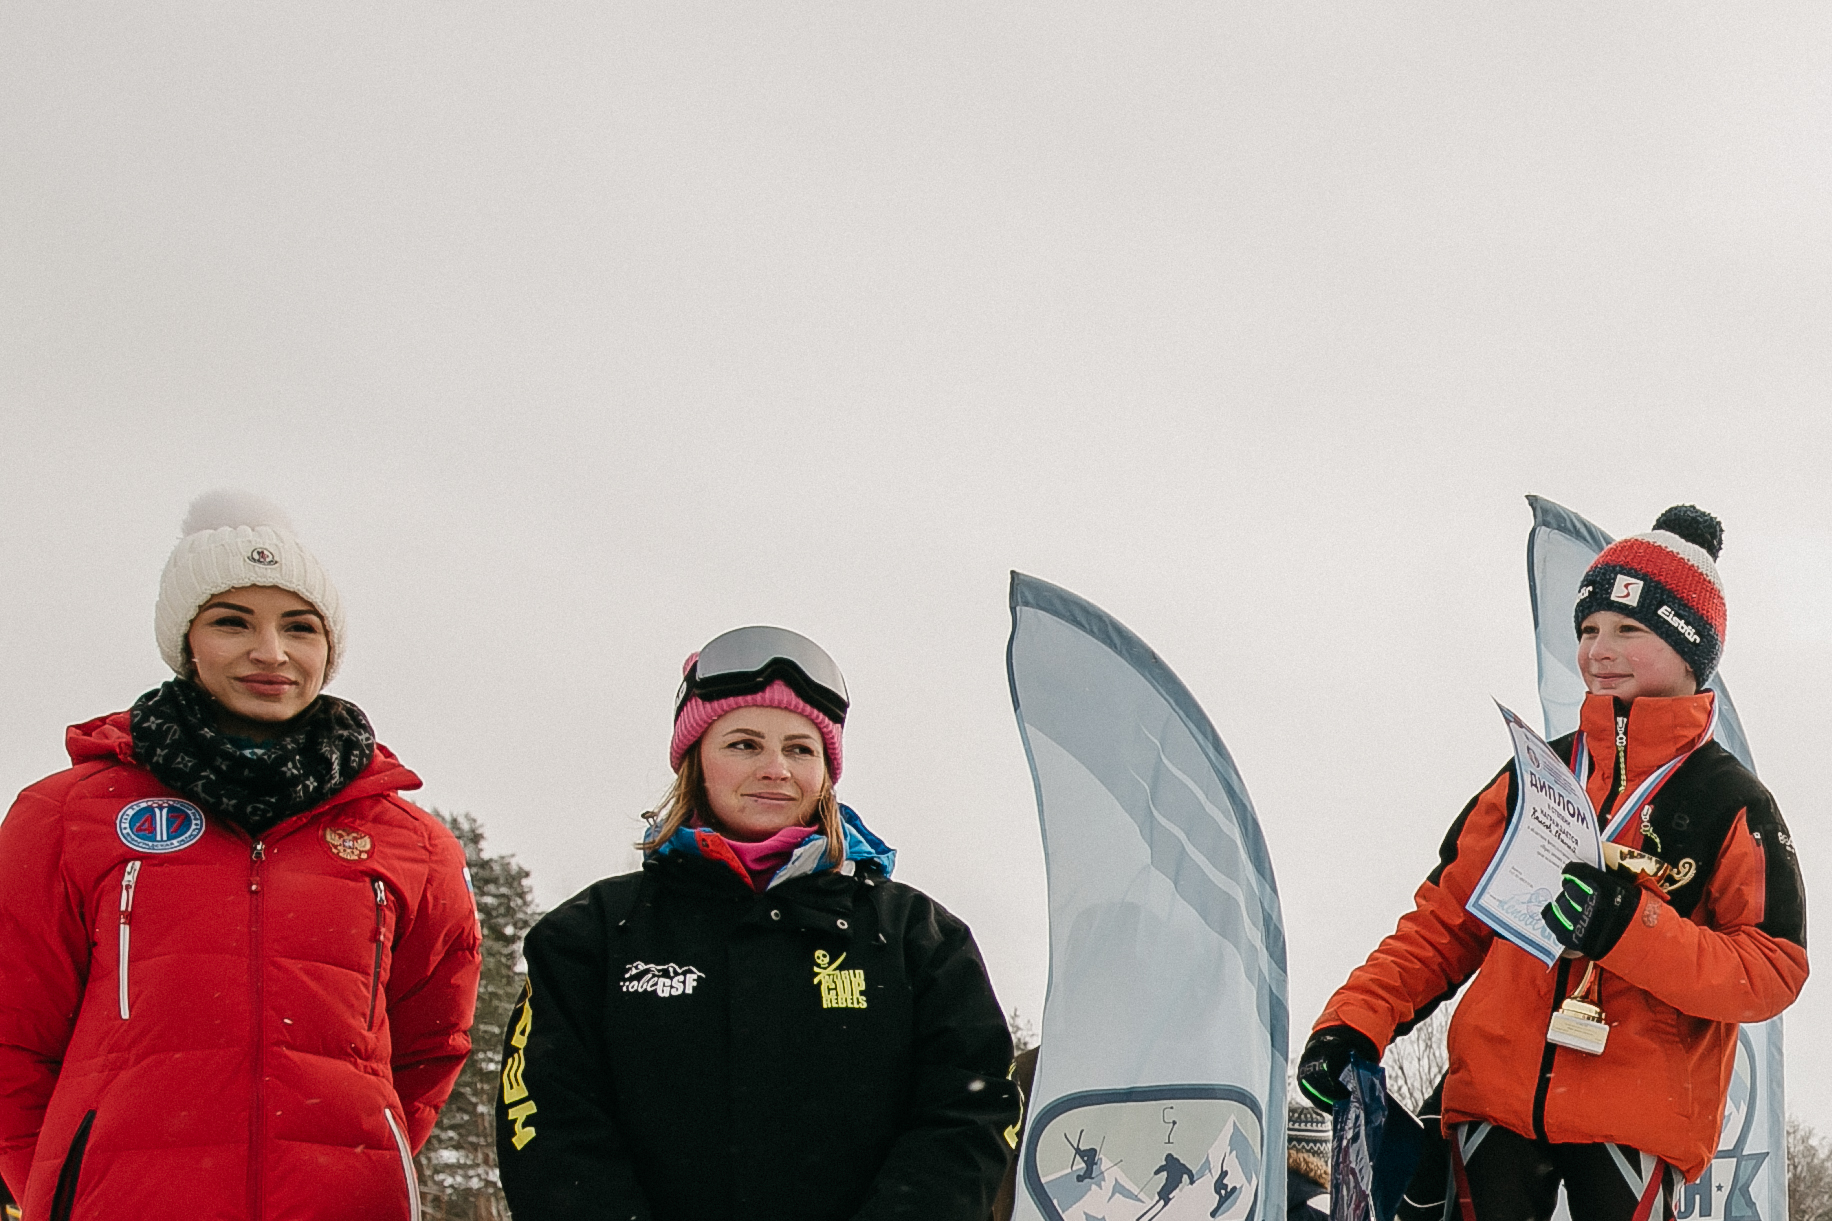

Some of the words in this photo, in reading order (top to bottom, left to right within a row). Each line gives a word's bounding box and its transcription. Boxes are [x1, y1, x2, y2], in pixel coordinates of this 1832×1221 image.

[1657, 605, 1700, 644] Eisbär
[1529, 769, 1590, 830] ДИПЛОМ
[820, 979, 866, 998] CUP
[822, 996, 868, 1009] REBELS
